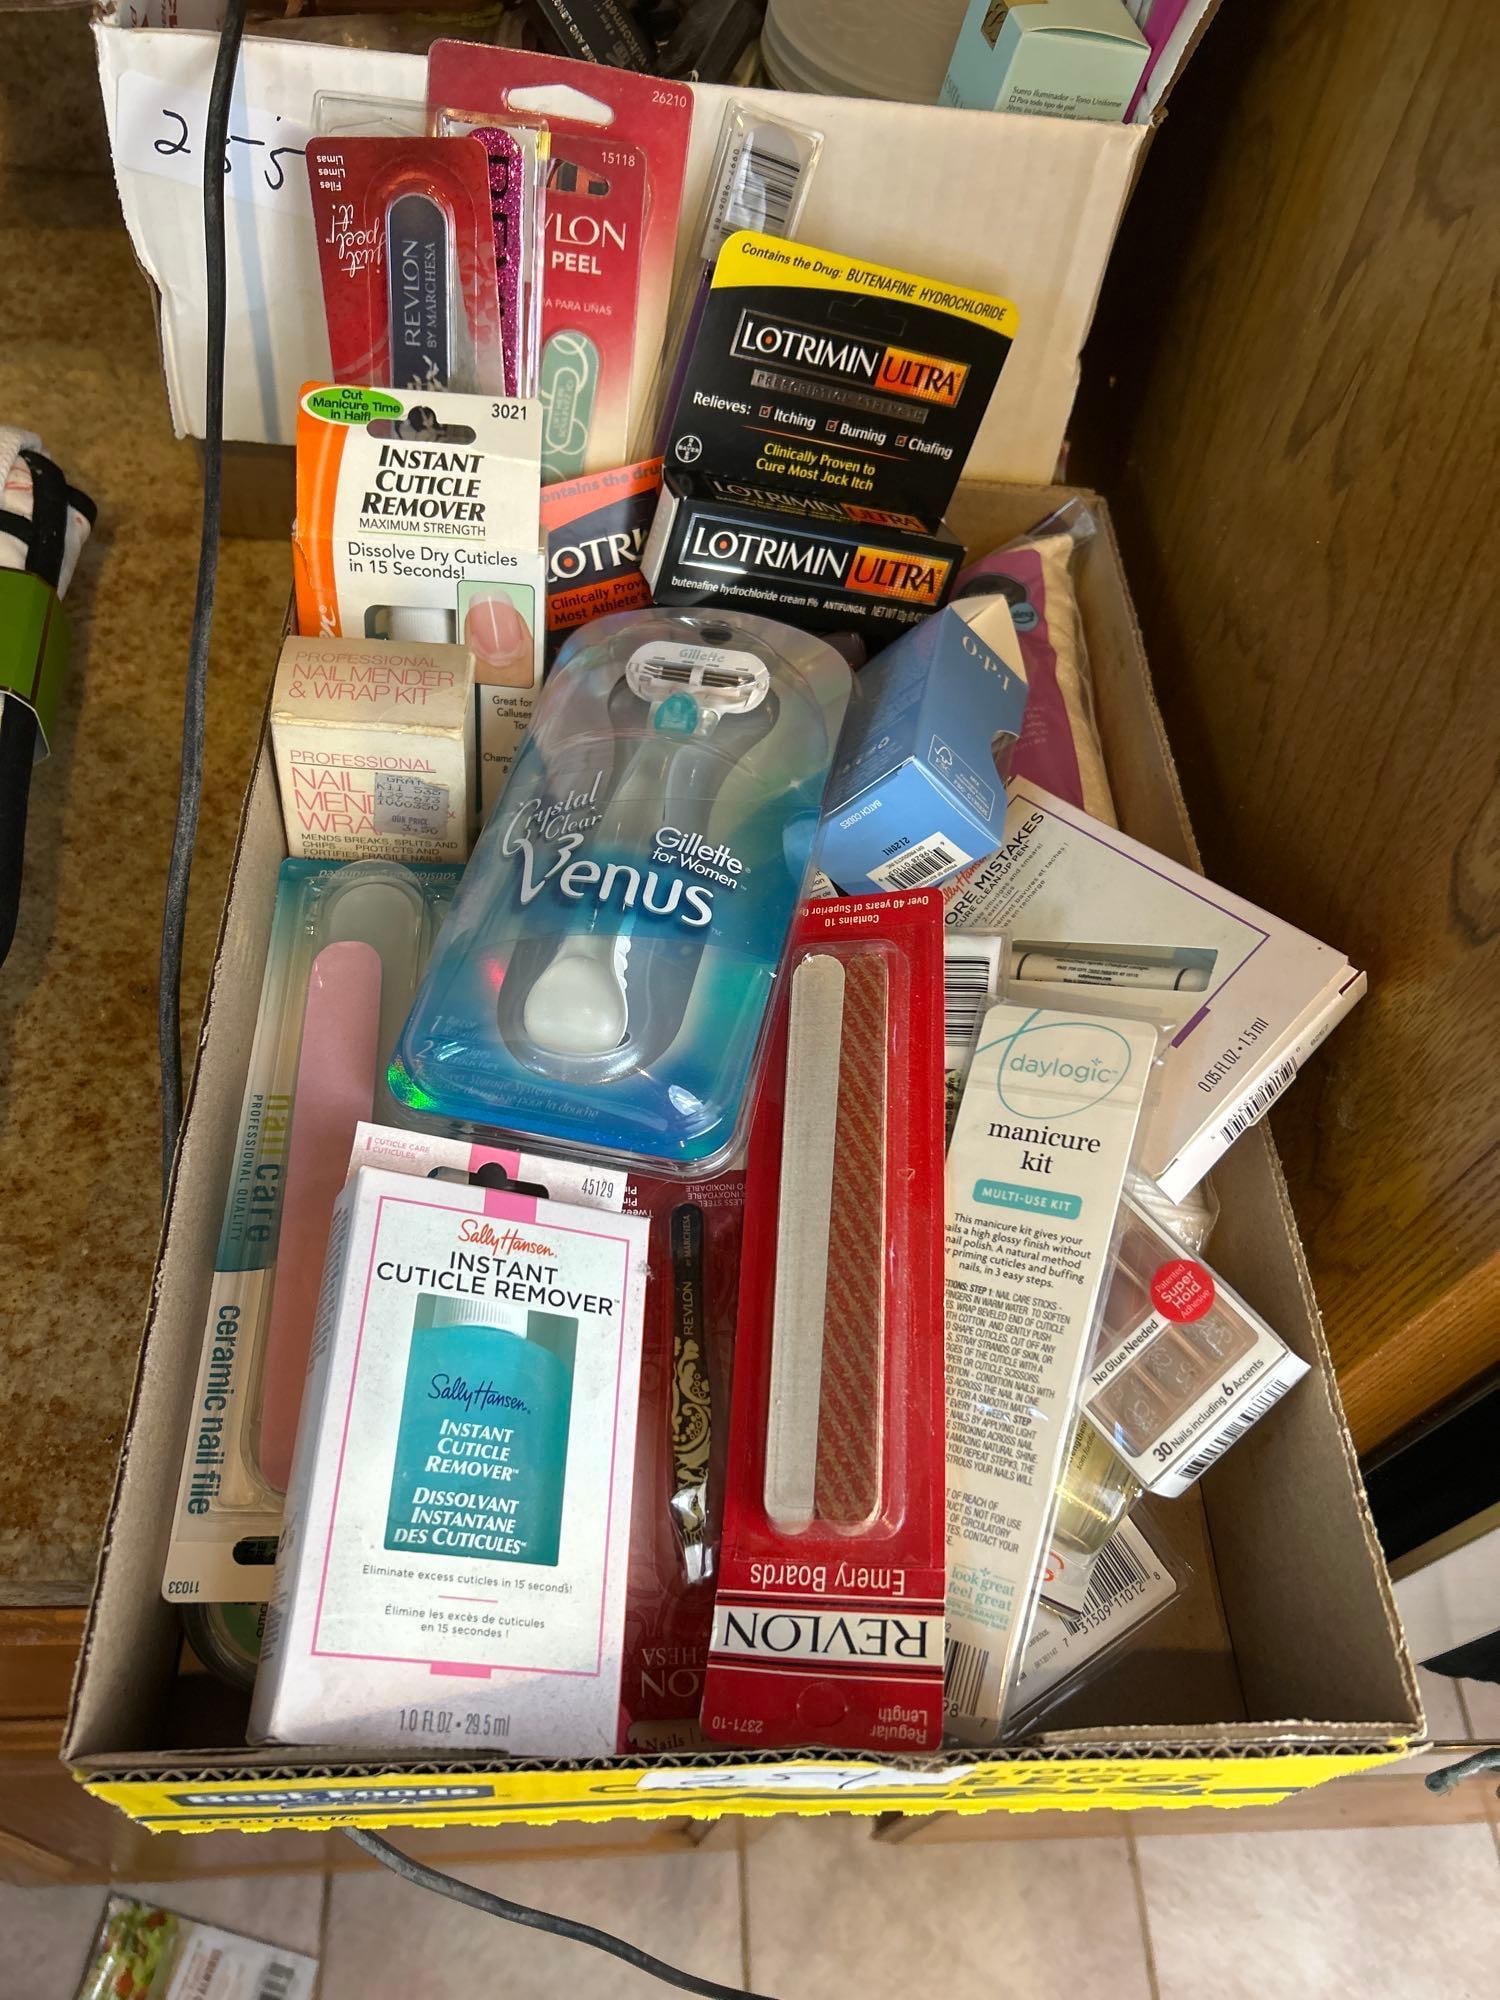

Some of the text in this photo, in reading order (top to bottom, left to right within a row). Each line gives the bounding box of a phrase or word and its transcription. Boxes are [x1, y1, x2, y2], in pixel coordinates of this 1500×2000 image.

[652, 90, 687, 108] 26210
[315, 154, 344, 165] Limas
[601, 151, 636, 168] 15118
[318, 168, 346, 179] Limes
[319, 181, 342, 192] Files
[551, 251, 602, 276] PEEL
[402, 240, 421, 347] REVLON
[424, 242, 437, 328] MARCHESA
[741, 242, 1007, 322] Contains the Drug: BUTENAFINE HYDROCHLORIDE
[741, 321, 957, 396] LOTRIMIN ULTRA
[312, 398, 401, 413] Manicure Time
[341, 388, 364, 400] Cut
[344, 411, 371, 422] Half!
[491, 403, 528, 421] 3021
[693, 392, 751, 415] Relieves:
[774, 408, 816, 431] Itching
[840, 423, 886, 446] Burning
[908, 437, 953, 460] Chafing
[378, 445, 484, 474] INSTANT
[764, 443, 875, 476] Clinically Proven to
[375, 470, 481, 499] CUTICLE
[756, 458, 873, 491] Cure Most Jock Itch
[361, 492, 485, 522] REMOVER
[359, 517, 486, 537] MAXIMUM STRENGTH
[348, 541, 518, 567] Dissolve Dry Cuticles
[692, 526, 937, 595] LOTRIMIN ULTRA
[349, 559, 465, 580] in 15 Seconds!
[551, 586, 610, 611] Clinically
[671, 575, 778, 602] butenafine hydrochloride
[296, 652, 440, 668] PROFESSIONAL
[679, 648, 725, 663] Gillette
[292, 664, 454, 687] NAIL MENDER
[289, 681, 433, 705] & WRAP KIT
[492, 696, 518, 708] Great
[291, 750, 435, 772] PROFESSIONAL
[291, 767, 366, 793] NAIL
[503, 771, 603, 857] Crystal
[544, 810, 602, 839] Clear
[839, 799, 882, 830] BATCH CODES
[302, 833, 458, 849] MENDS AND
[416, 848, 440, 856] AND
[655, 827, 743, 875] Gillette
[511, 832, 713, 927] Venus
[653, 847, 738, 889] for Women
[944, 812, 1044, 927] ORE MISTAKES
[976, 864, 1010, 904] CLEAN-UP
[811, 896, 929, 915] Over 40 years Superior
[825, 914, 880, 927] Contains 10
[1010, 1054, 1111, 1083] daylogic
[987, 1122, 1101, 1153] manicure
[230, 1094, 264, 1241] PROFESSIONAL QUALITY
[1019, 1151, 1053, 1174] kit
[581, 1178, 614, 1199] 45129
[981, 1186, 1072, 1211] MULTI-USE KIT
[248, 1164, 280, 1243] care
[458, 1219, 556, 1257] Sally Hansen
[955, 1213, 1083, 1246] This manicure kit gives your
[971, 1227, 1091, 1260] high glossy finish without
[450, 1251, 558, 1285] INSTANT
[952, 1248, 1084, 1285] priming cuticles and buffing
[1006, 1247, 1081, 1270] natural method
[377, 1262, 613, 1316] CUTICLE REMOVER
[1002, 1270, 1023, 1283] easy
[1155, 1264, 1185, 1293] Patented
[1161, 1270, 1194, 1303] Super
[681, 1281, 694, 1336] REVLON
[1171, 1281, 1201, 1309] Hold
[1180, 1290, 1210, 1319] Adhesive
[1092, 1319, 1159, 1385] No Glue Needed
[428, 1373, 527, 1413] Sally Hansen
[187, 1304, 241, 1515] ceramic nail file
[1152, 1358, 1264, 1463] 30 Nails including Accents
[440, 1419, 514, 1443] INSTANT
[437, 1438, 511, 1461] CUTICLE
[425, 1456, 513, 1482] REMOVER
[413, 1487, 519, 1514] DISSOLVANT
[411, 1508, 516, 1534] INSTANTANE
[393, 1528, 522, 1555] DES CUTICULES
[168, 1581, 200, 1594] 11033
[362, 1565, 572, 1594] Eliminate excess cuticles seconds!
[750, 1562, 906, 1595] Emery Boards
[980, 1575, 1014, 1597] great
[385, 1605, 545, 1629] Élimine les excès cuticules
[1081, 1581, 1146, 1635] 31509 11012
[451, 1625, 502, 1638] secondes
[723, 1611, 928, 1658] REVLON
[400, 1708, 510, 1737] 1.0 29.5 ml
[712, 1715, 764, 1733] 2371-10
[878, 1704, 928, 1723] Length
[869, 1722, 927, 1744] Regular
